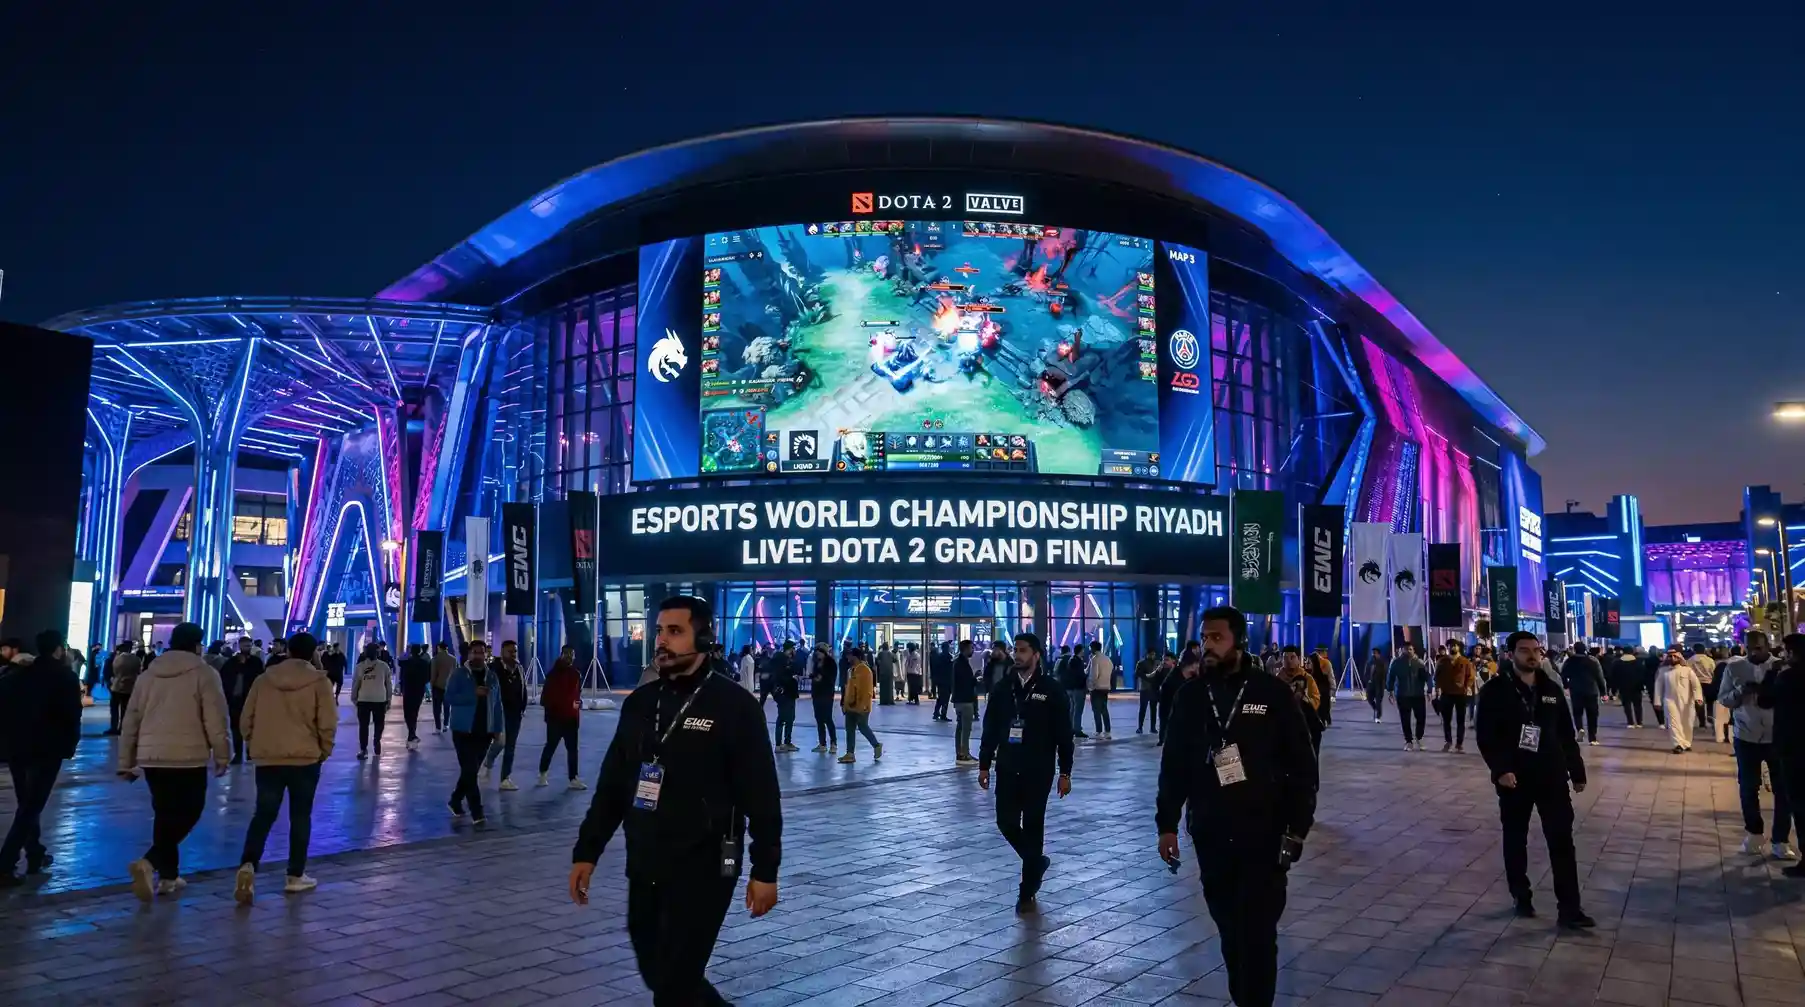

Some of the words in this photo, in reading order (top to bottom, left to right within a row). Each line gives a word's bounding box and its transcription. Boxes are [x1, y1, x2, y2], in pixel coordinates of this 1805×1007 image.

[878, 195, 936, 209] DOTA
[942, 195, 952, 209] 2
[970, 197, 1019, 210] VALVE
[1169, 249, 1189, 262] MAP
[1189, 254, 1195, 264] 3
[631, 502, 758, 535] ESPORTS
[764, 500, 881, 529] WORLD
[889, 499, 1128, 531] CHAMPIONSHIP
[1135, 505, 1223, 537] RIYADH
[512, 524, 529, 592] EWC
[742, 538, 812, 565] LIVE:
[821, 538, 900, 564] DOTA
[908, 537, 925, 564] 2
[935, 537, 1038, 564] GRAND
[1046, 539, 1127, 566] FINAL
[1313, 526, 1332, 594] EWC
[1242, 703, 1268, 712] EWC
[683, 717, 714, 728] EWC
